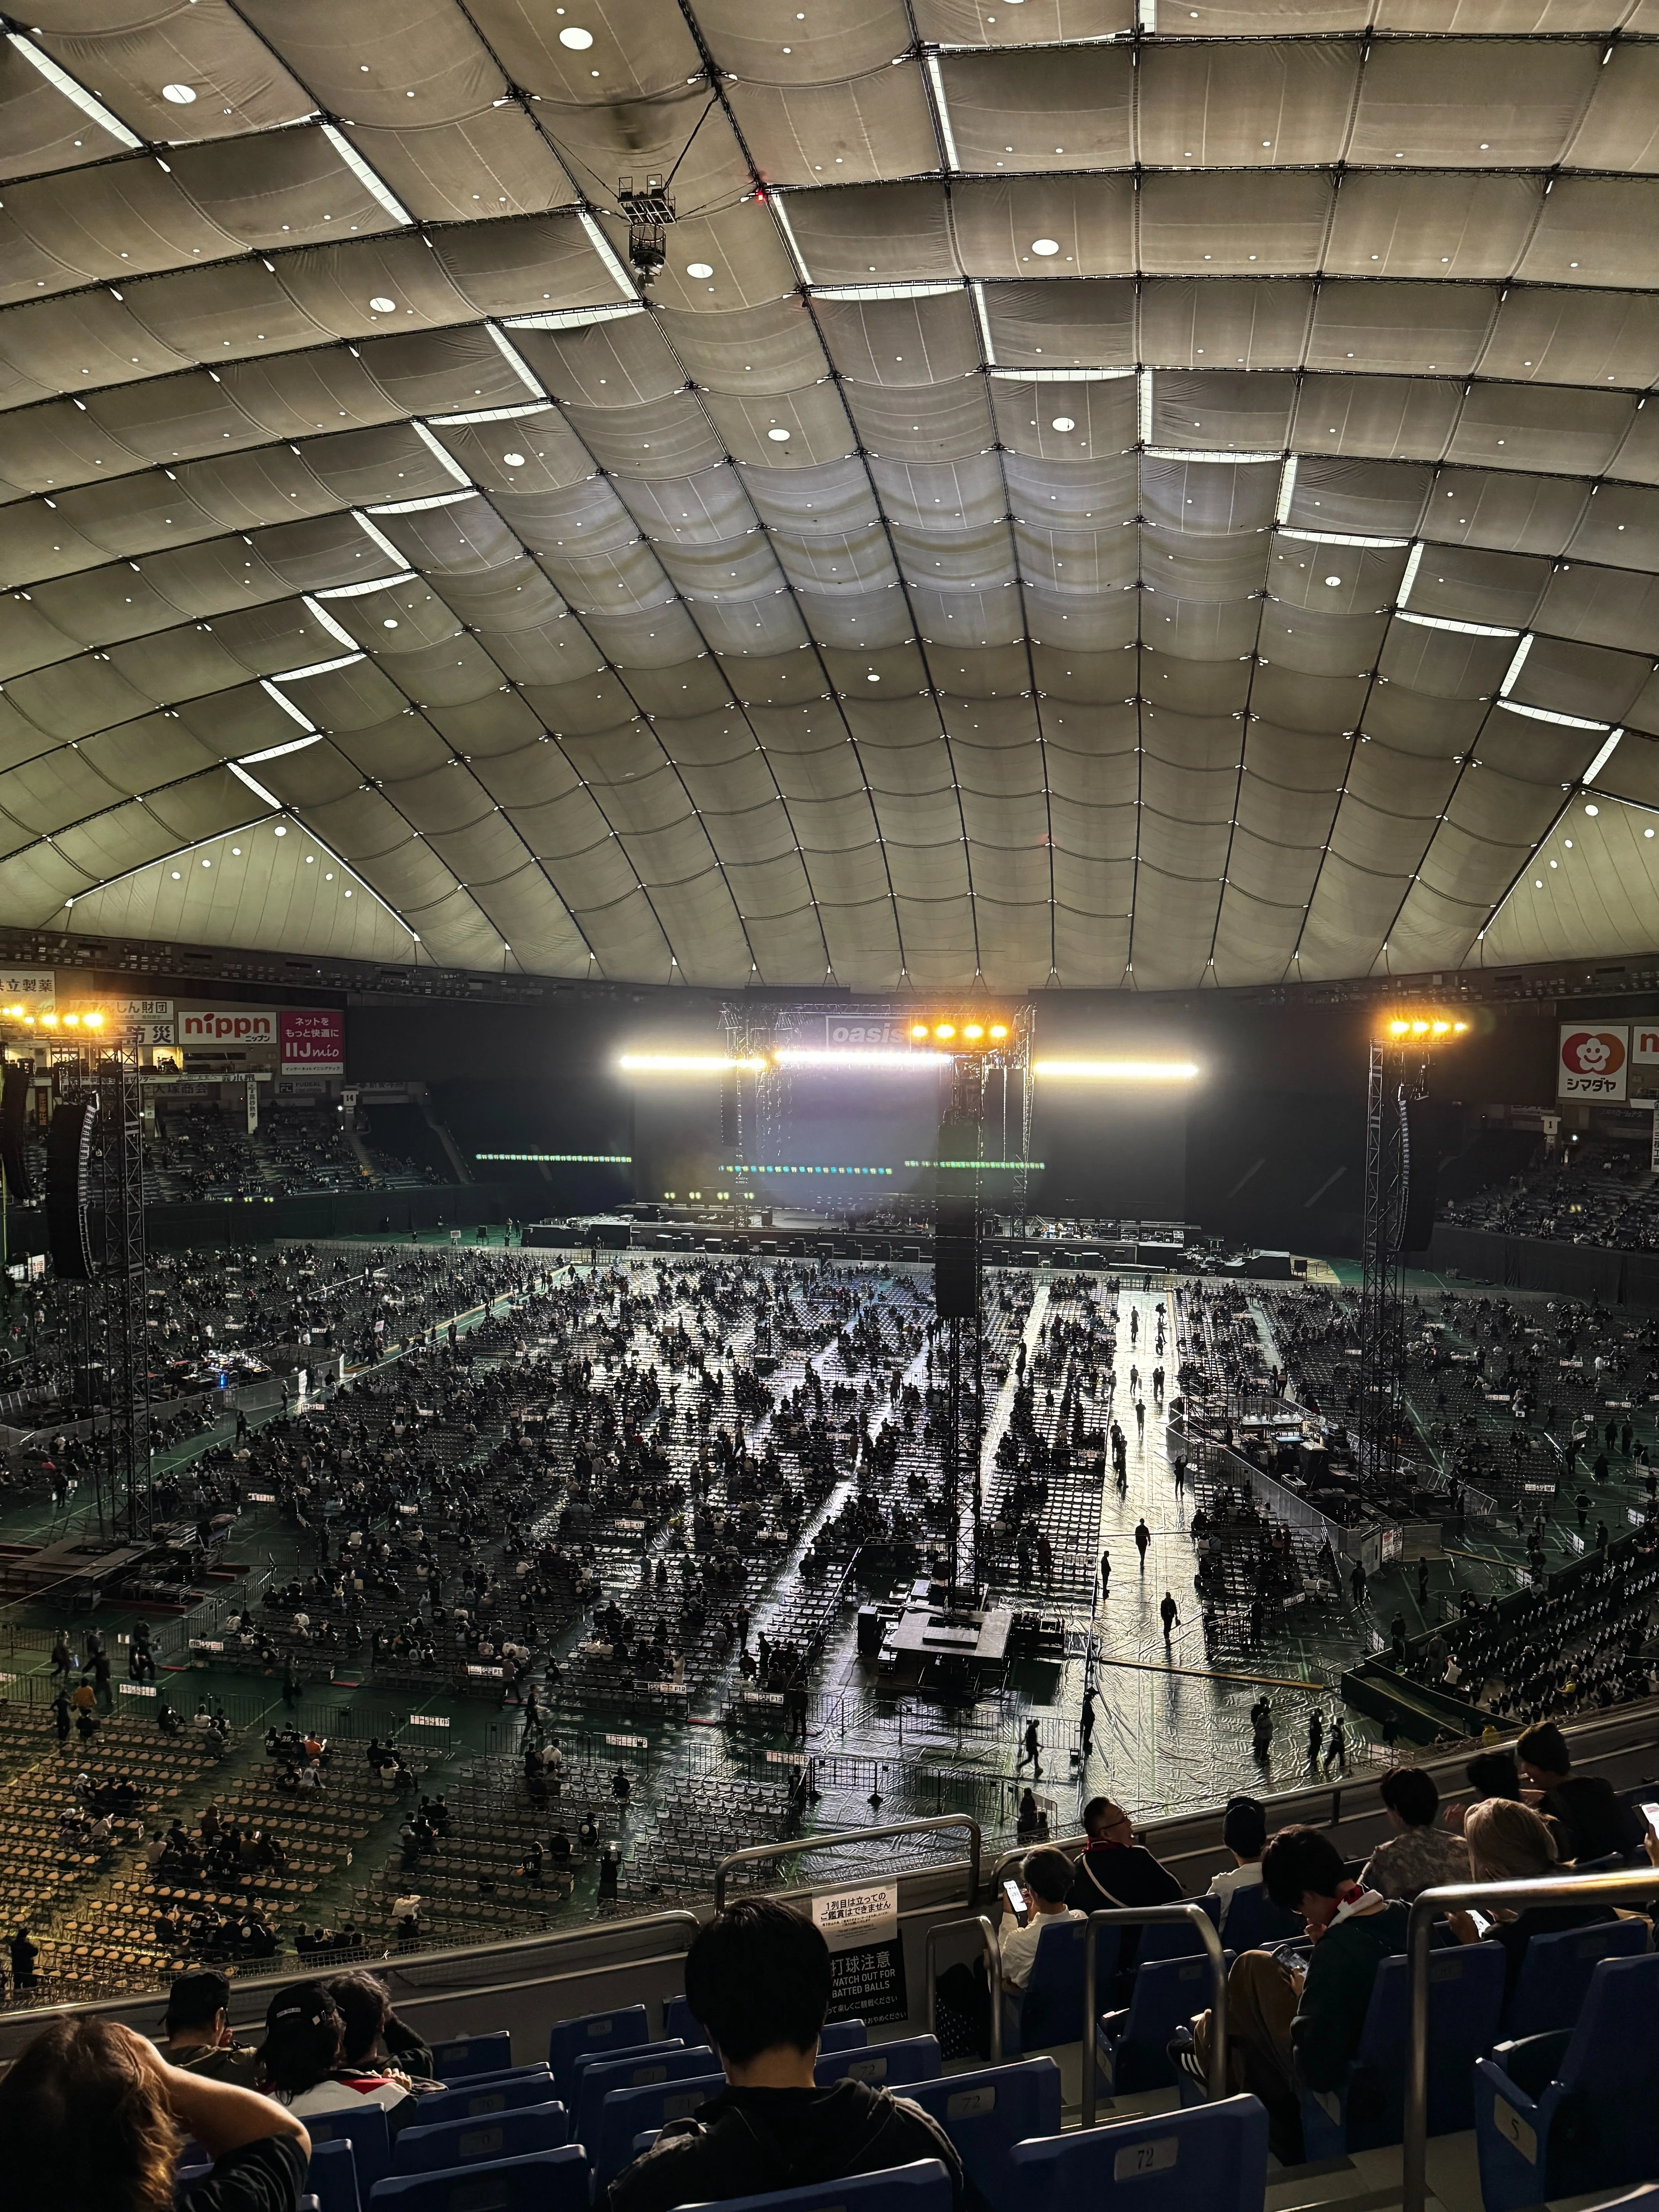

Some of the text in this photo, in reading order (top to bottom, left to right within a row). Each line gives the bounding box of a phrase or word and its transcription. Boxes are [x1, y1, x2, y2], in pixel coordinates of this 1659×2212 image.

[185, 1013, 270, 1038] nippn
[295, 1017, 329, 1026] ネットを
[285, 1029, 339, 1037] もっと快適に
[832, 1023, 905, 1043] oasis
[1567, 1077, 1616, 1092] シマダヤ
[826, 1892, 886, 1910] 1列目は立っての
[821, 1901, 891, 1920] ご鑑賞はできません
[191, 1919, 202, 1928] 25
[831, 1951, 890, 1977] 打球注意
[862, 1972, 878, 1981] OUT
[880, 1969, 895, 1978] FOR
[833, 1980, 890, 1998] BATTED BALLS
[860, 2064, 875, 2076] 72
[962, 2095, 981, 2111] 72
[1137, 2147, 1155, 2171] 72
